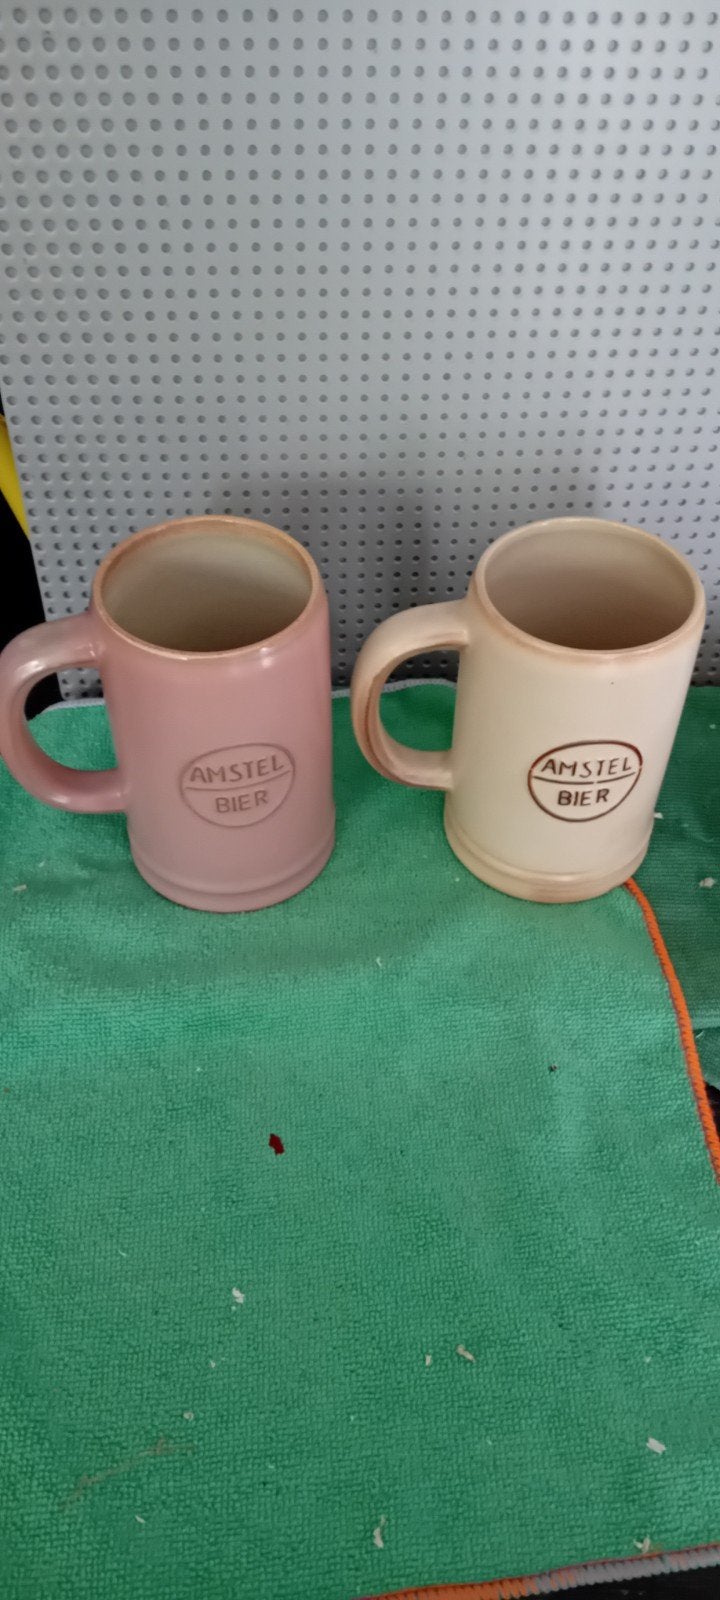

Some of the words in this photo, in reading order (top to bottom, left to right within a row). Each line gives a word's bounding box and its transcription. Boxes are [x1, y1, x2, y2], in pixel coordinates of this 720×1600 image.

[190, 755, 285, 783] AMSTEL
[541, 757, 631, 778] AMSTEL
[215, 790, 268, 813] BIER
[557, 788, 610, 806] BIER
